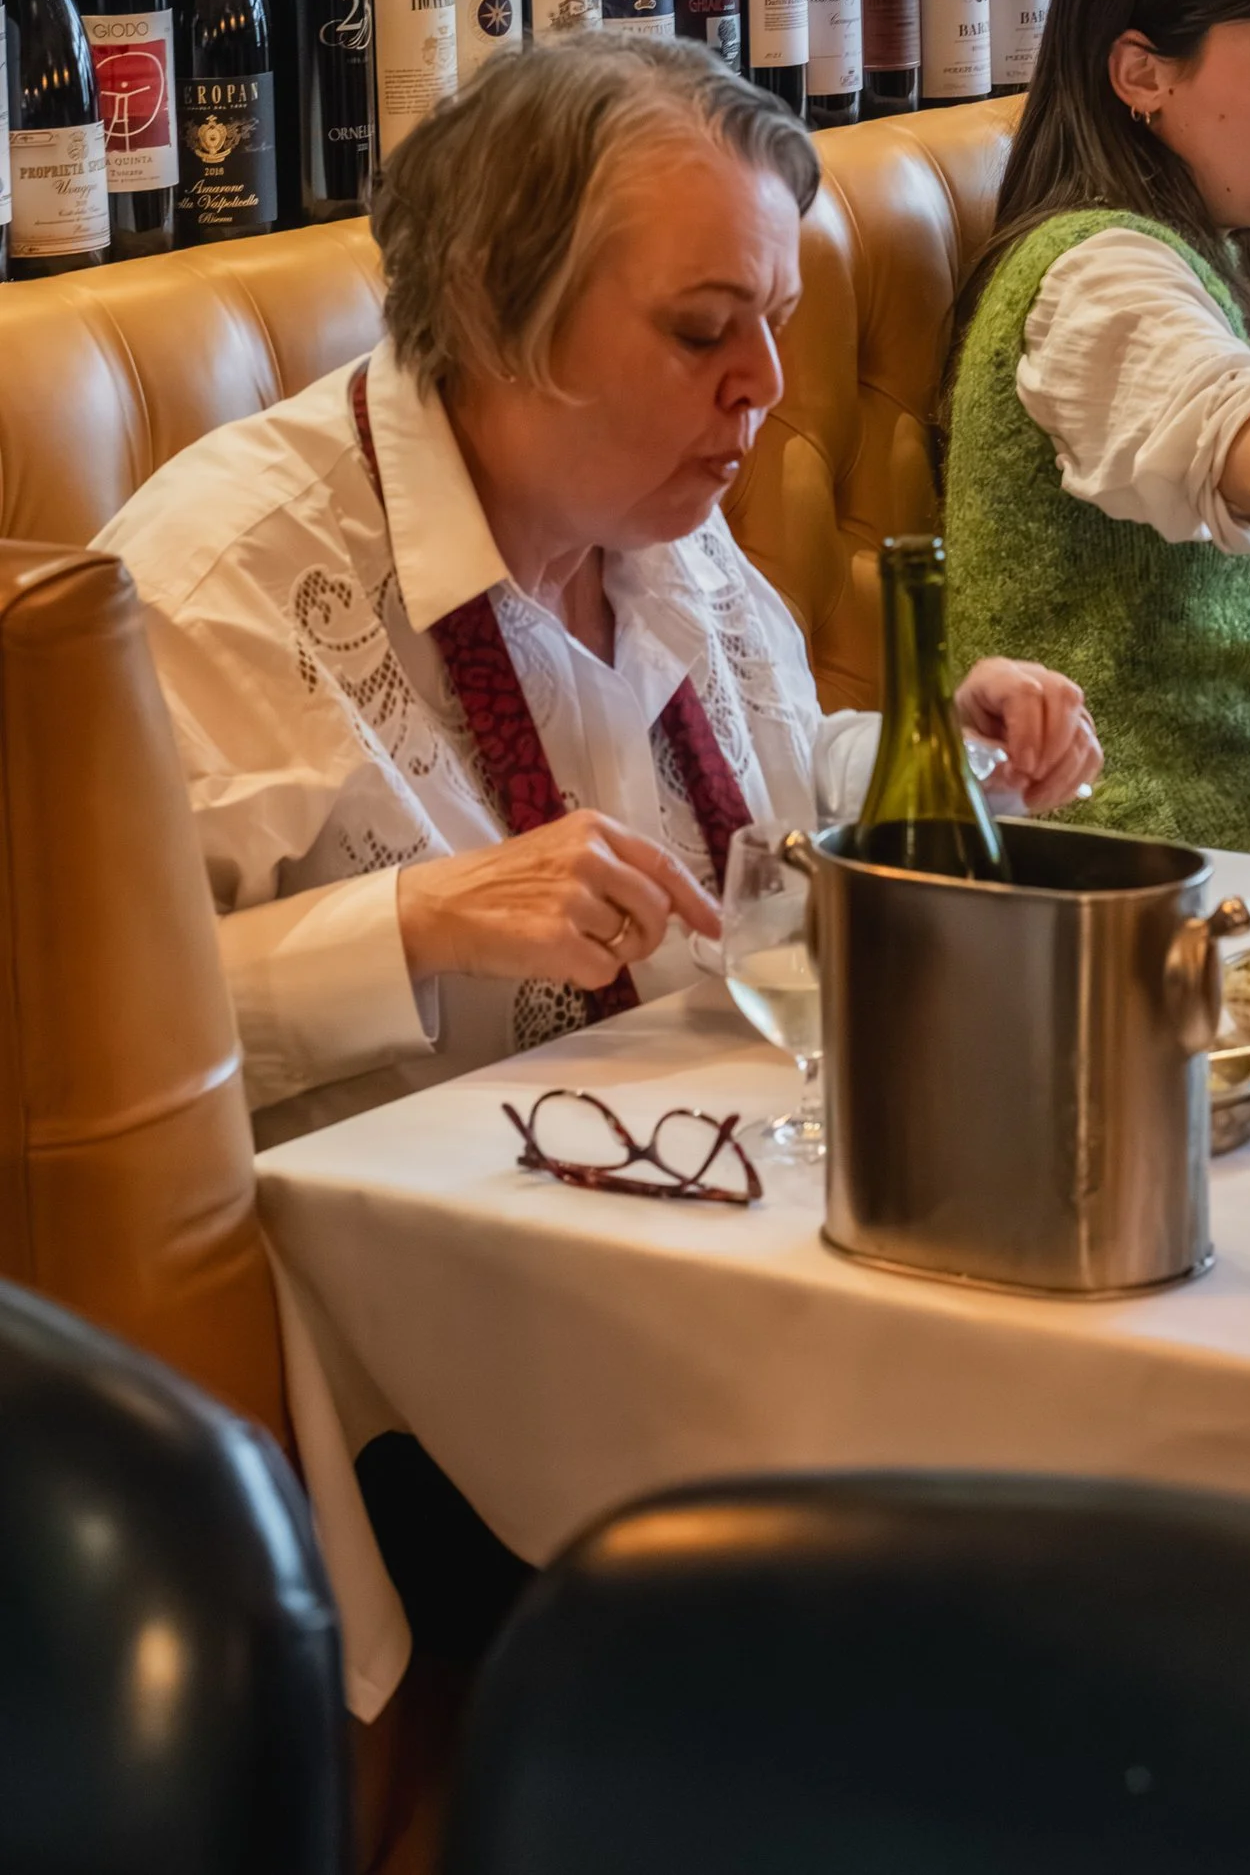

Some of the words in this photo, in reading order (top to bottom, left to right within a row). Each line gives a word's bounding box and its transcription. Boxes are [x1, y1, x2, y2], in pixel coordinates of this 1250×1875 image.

[92, 21, 149, 39] GIODO
[114, 156, 154, 168] QUINTA
[184, 179, 245, 195] Amarone
[197, 192, 260, 214] Valpolicella
